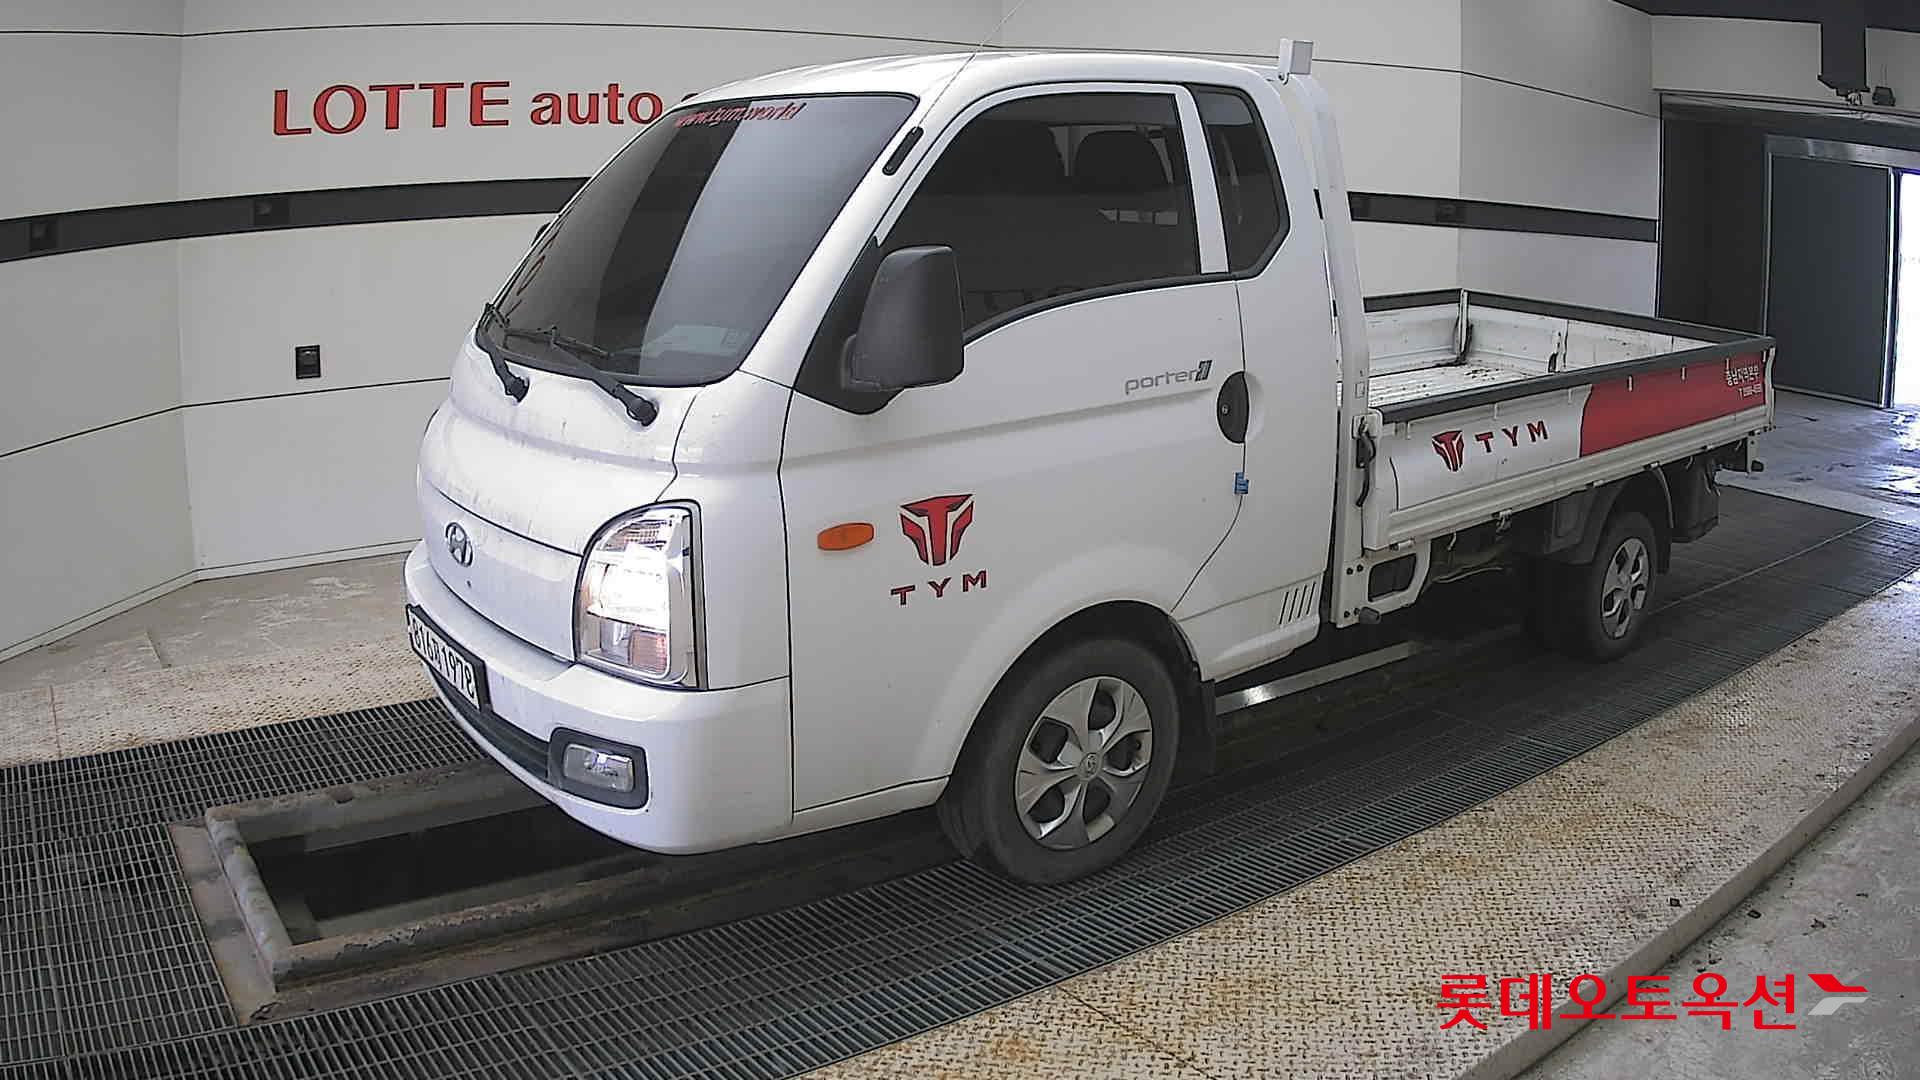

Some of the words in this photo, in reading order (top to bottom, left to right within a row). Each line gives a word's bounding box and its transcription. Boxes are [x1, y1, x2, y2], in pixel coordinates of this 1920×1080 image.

[273, 81, 510, 136] LOTTE
[530, 82, 664, 126] auto
[1475, 419, 1549, 453] TYM
[890, 569, 988, 607] TYM
